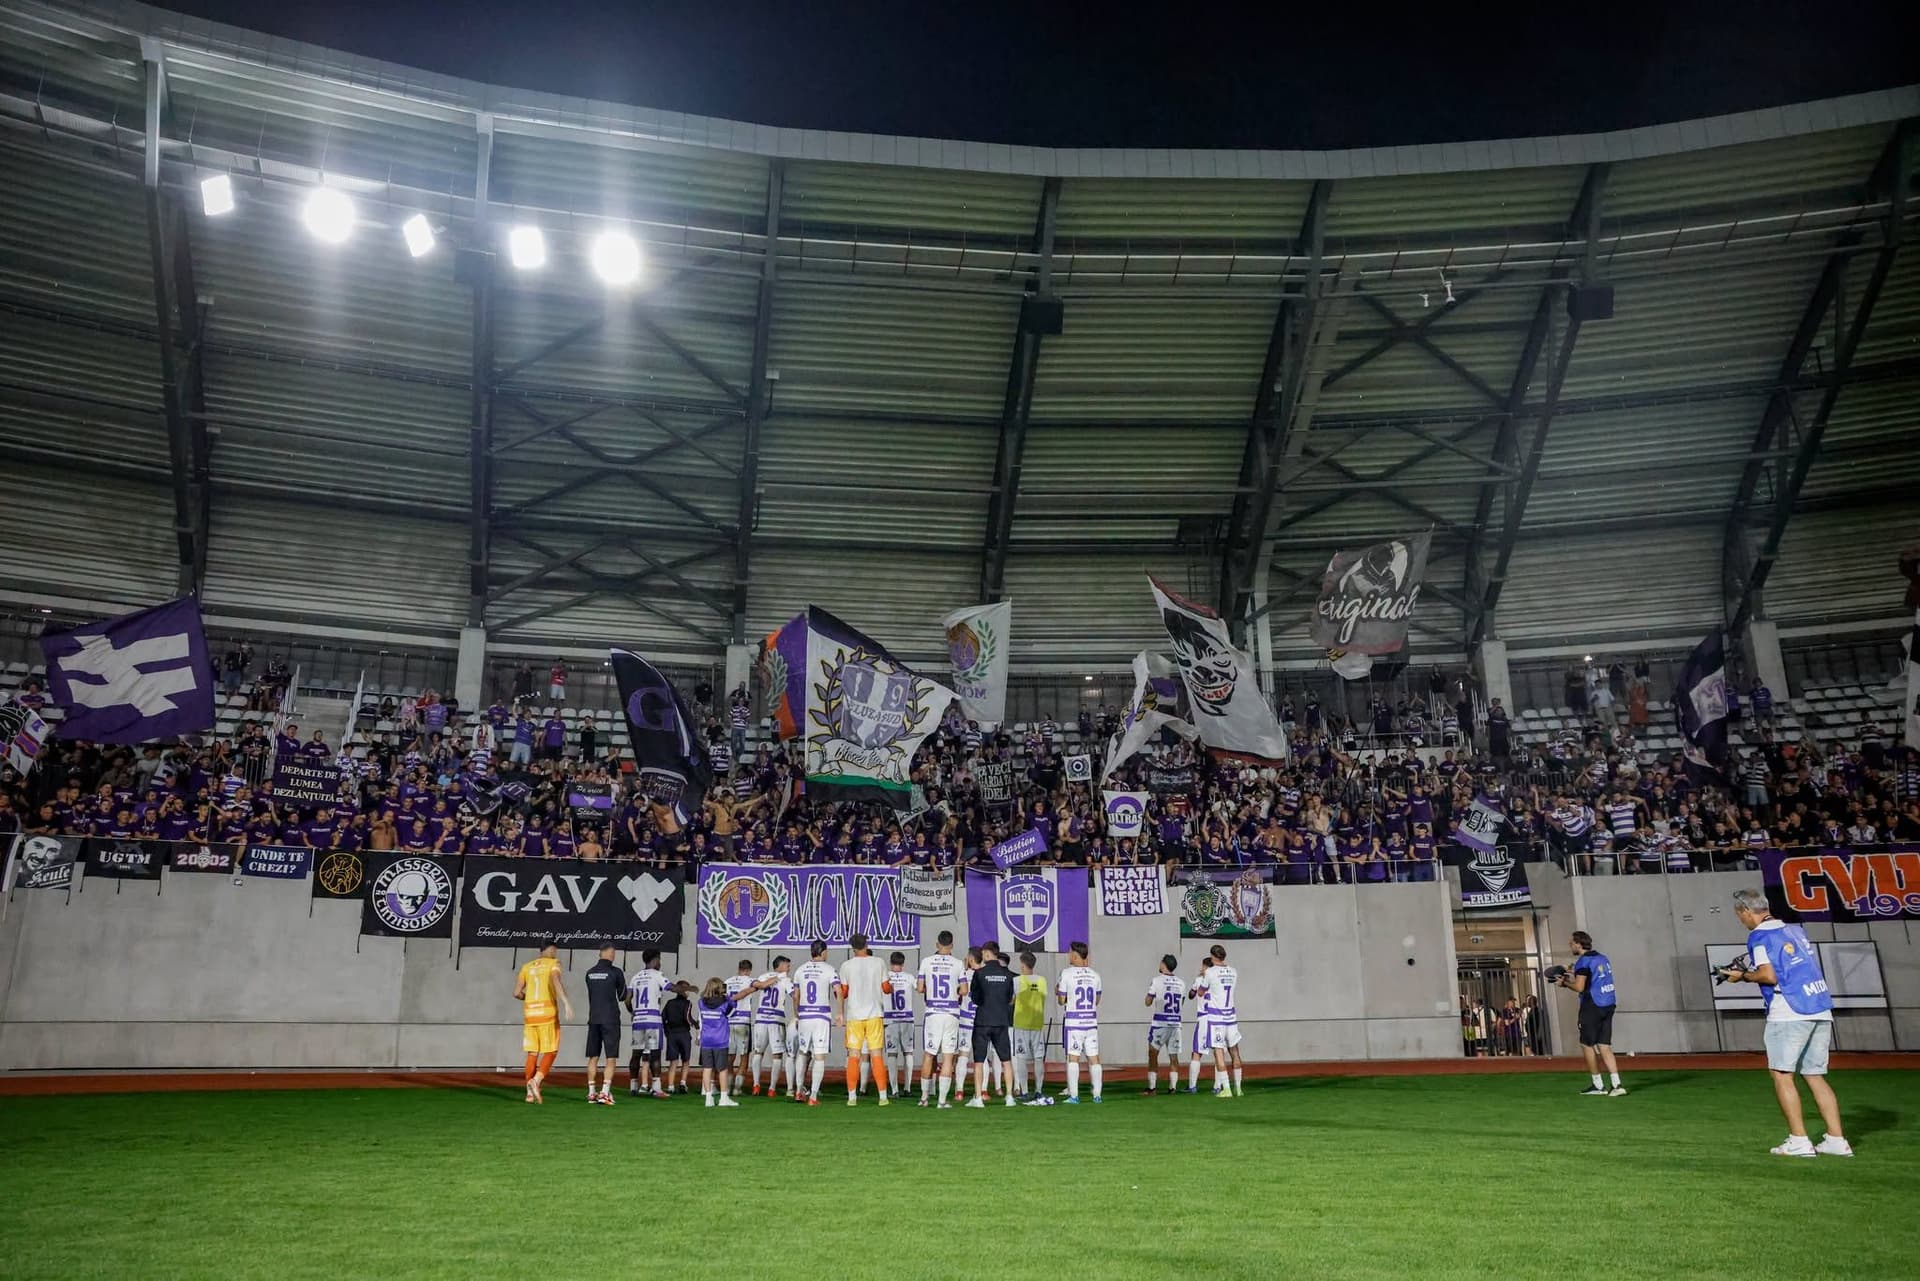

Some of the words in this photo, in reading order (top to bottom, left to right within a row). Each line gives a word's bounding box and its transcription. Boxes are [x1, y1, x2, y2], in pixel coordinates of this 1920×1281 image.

[280, 765, 323, 778] DEPARTE
[324, 771, 338, 780] DE
[290, 778, 323, 790] LUMEA
[1108, 812, 1143, 825] ULTRAS
[251, 848, 285, 862] UNDE
[289, 852, 305, 862] TE
[997, 836, 1036, 857] Bastion
[99, 851, 152, 865] UGTM
[1003, 848, 1034, 865] Ultras
[249, 862, 297, 874] CREZI?
[472, 871, 608, 914] GAV
[1104, 889, 1160, 903] MEREU
[1470, 889, 1523, 905] FRENETIC
[1105, 902, 1126, 914] CU
[1131, 901, 1161, 914] NOI
[477, 926, 509, 937] Fondat
[633, 930, 664, 942] 2007
[806, 981, 817, 1004] 8
[932, 974, 950, 999] 15
[635, 986, 650, 1008] 14
[761, 987, 779, 1008] 20
[891, 989, 905, 1011] 16
[1075, 986, 1094, 1010] 29
[1164, 992, 1181, 1014] 25
[1223, 985, 1232, 1007] 7
